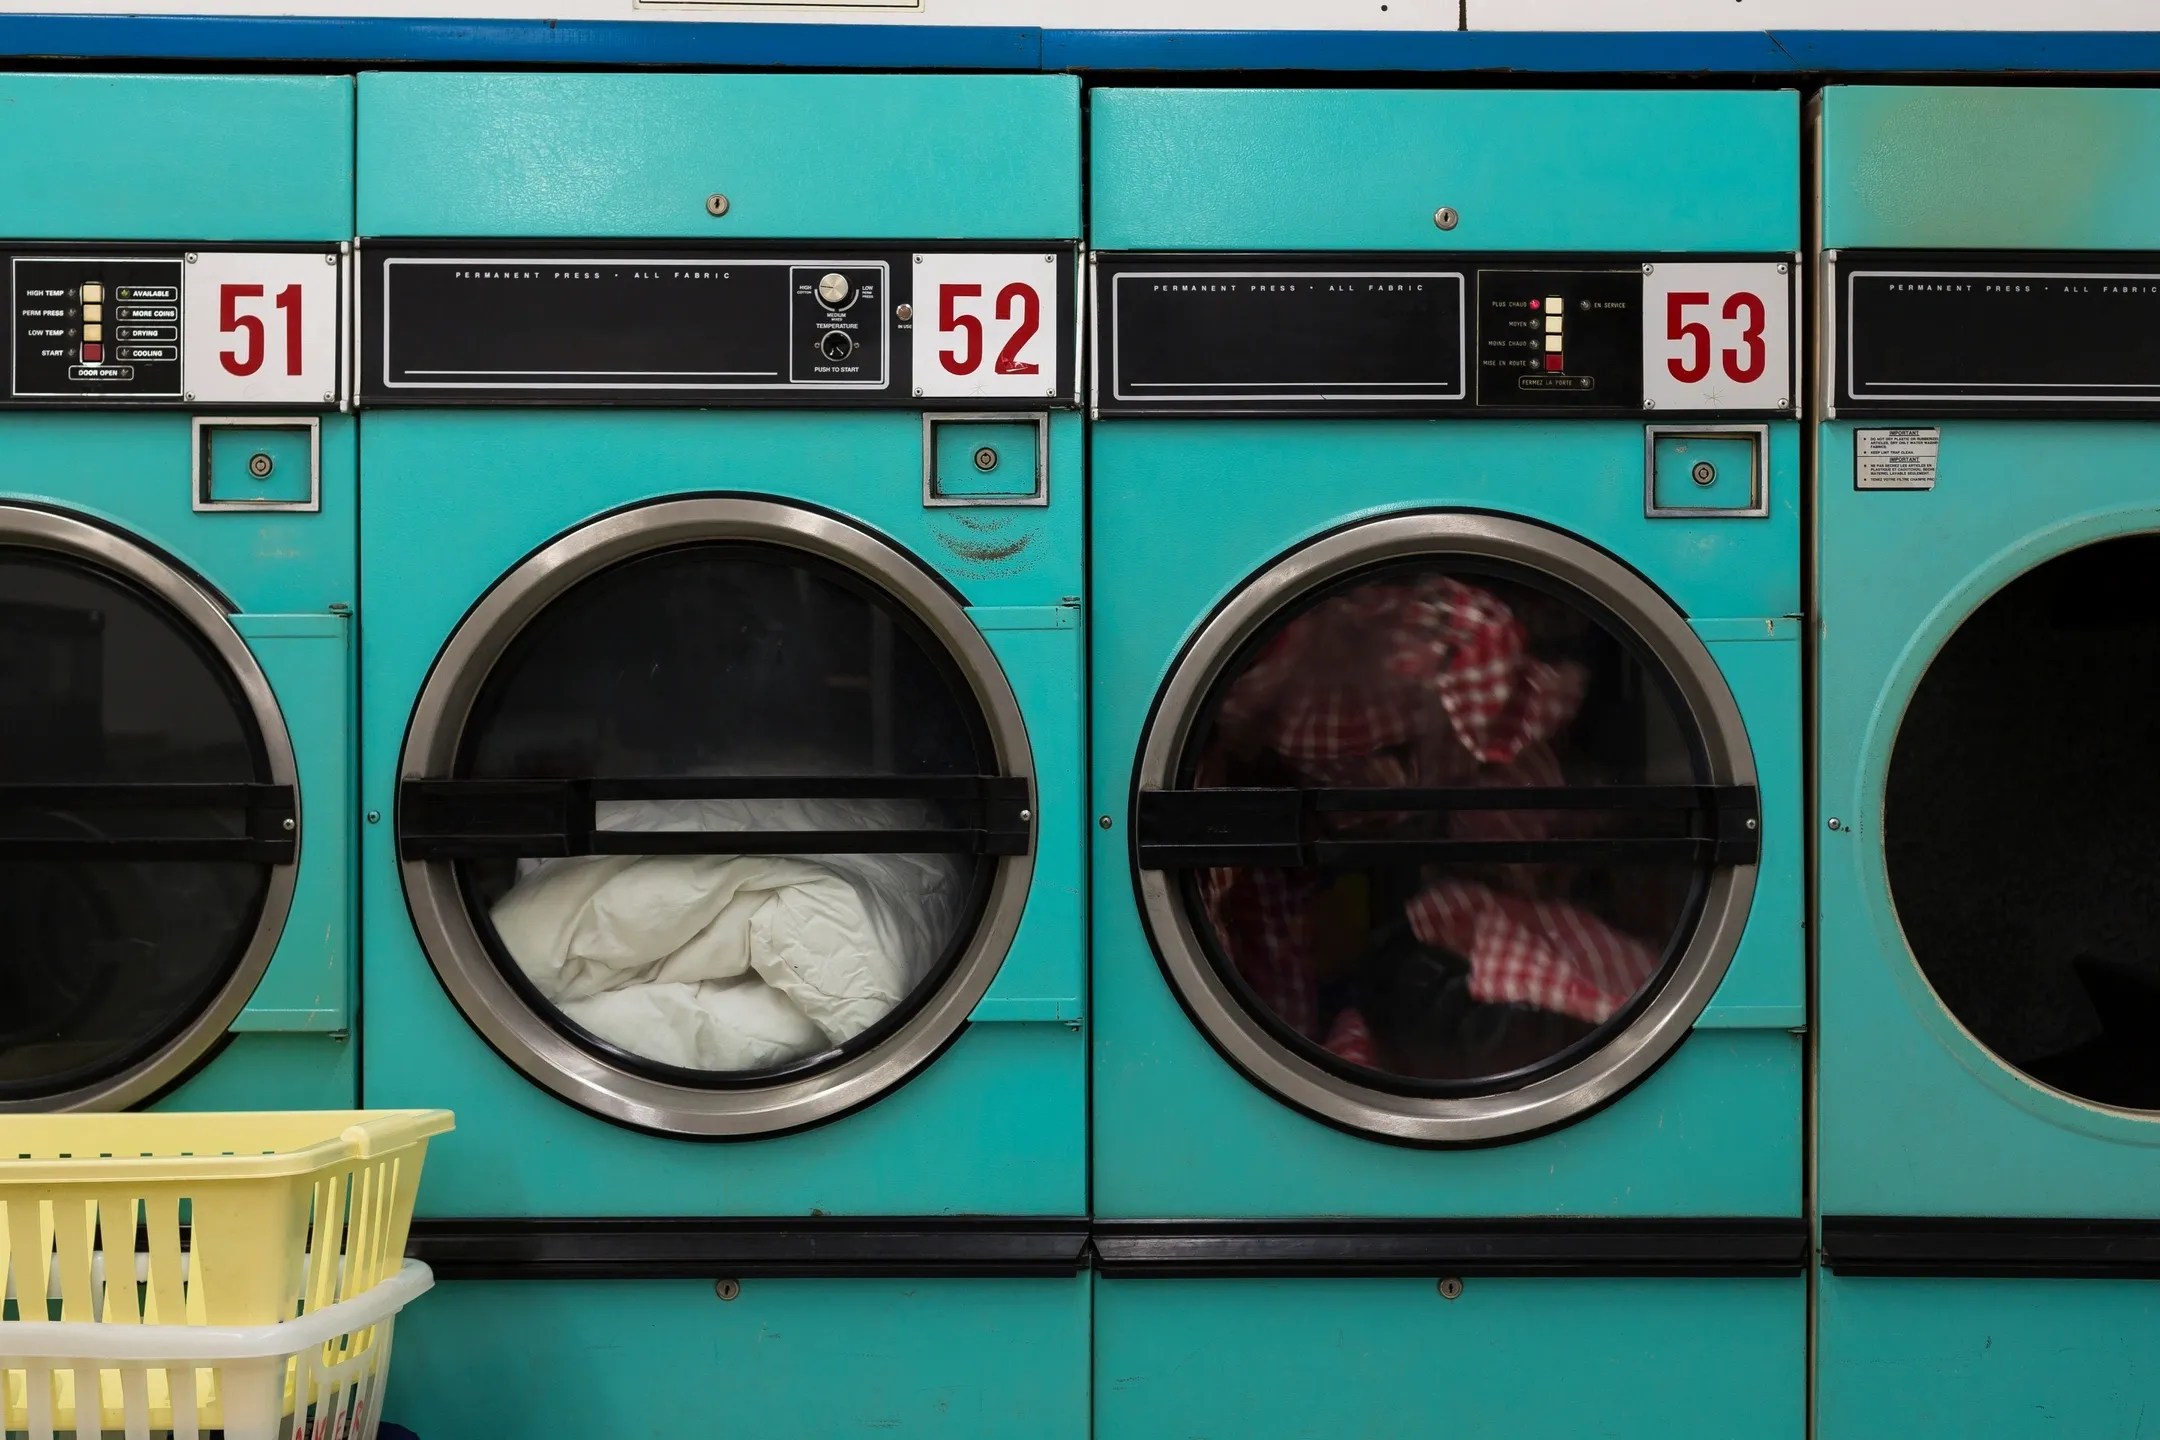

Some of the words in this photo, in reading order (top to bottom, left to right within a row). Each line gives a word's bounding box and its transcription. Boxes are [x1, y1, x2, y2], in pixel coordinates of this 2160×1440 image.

[219, 283, 303, 376] 51
[938, 282, 1040, 376] 52
[1667, 292, 1766, 384] 53
